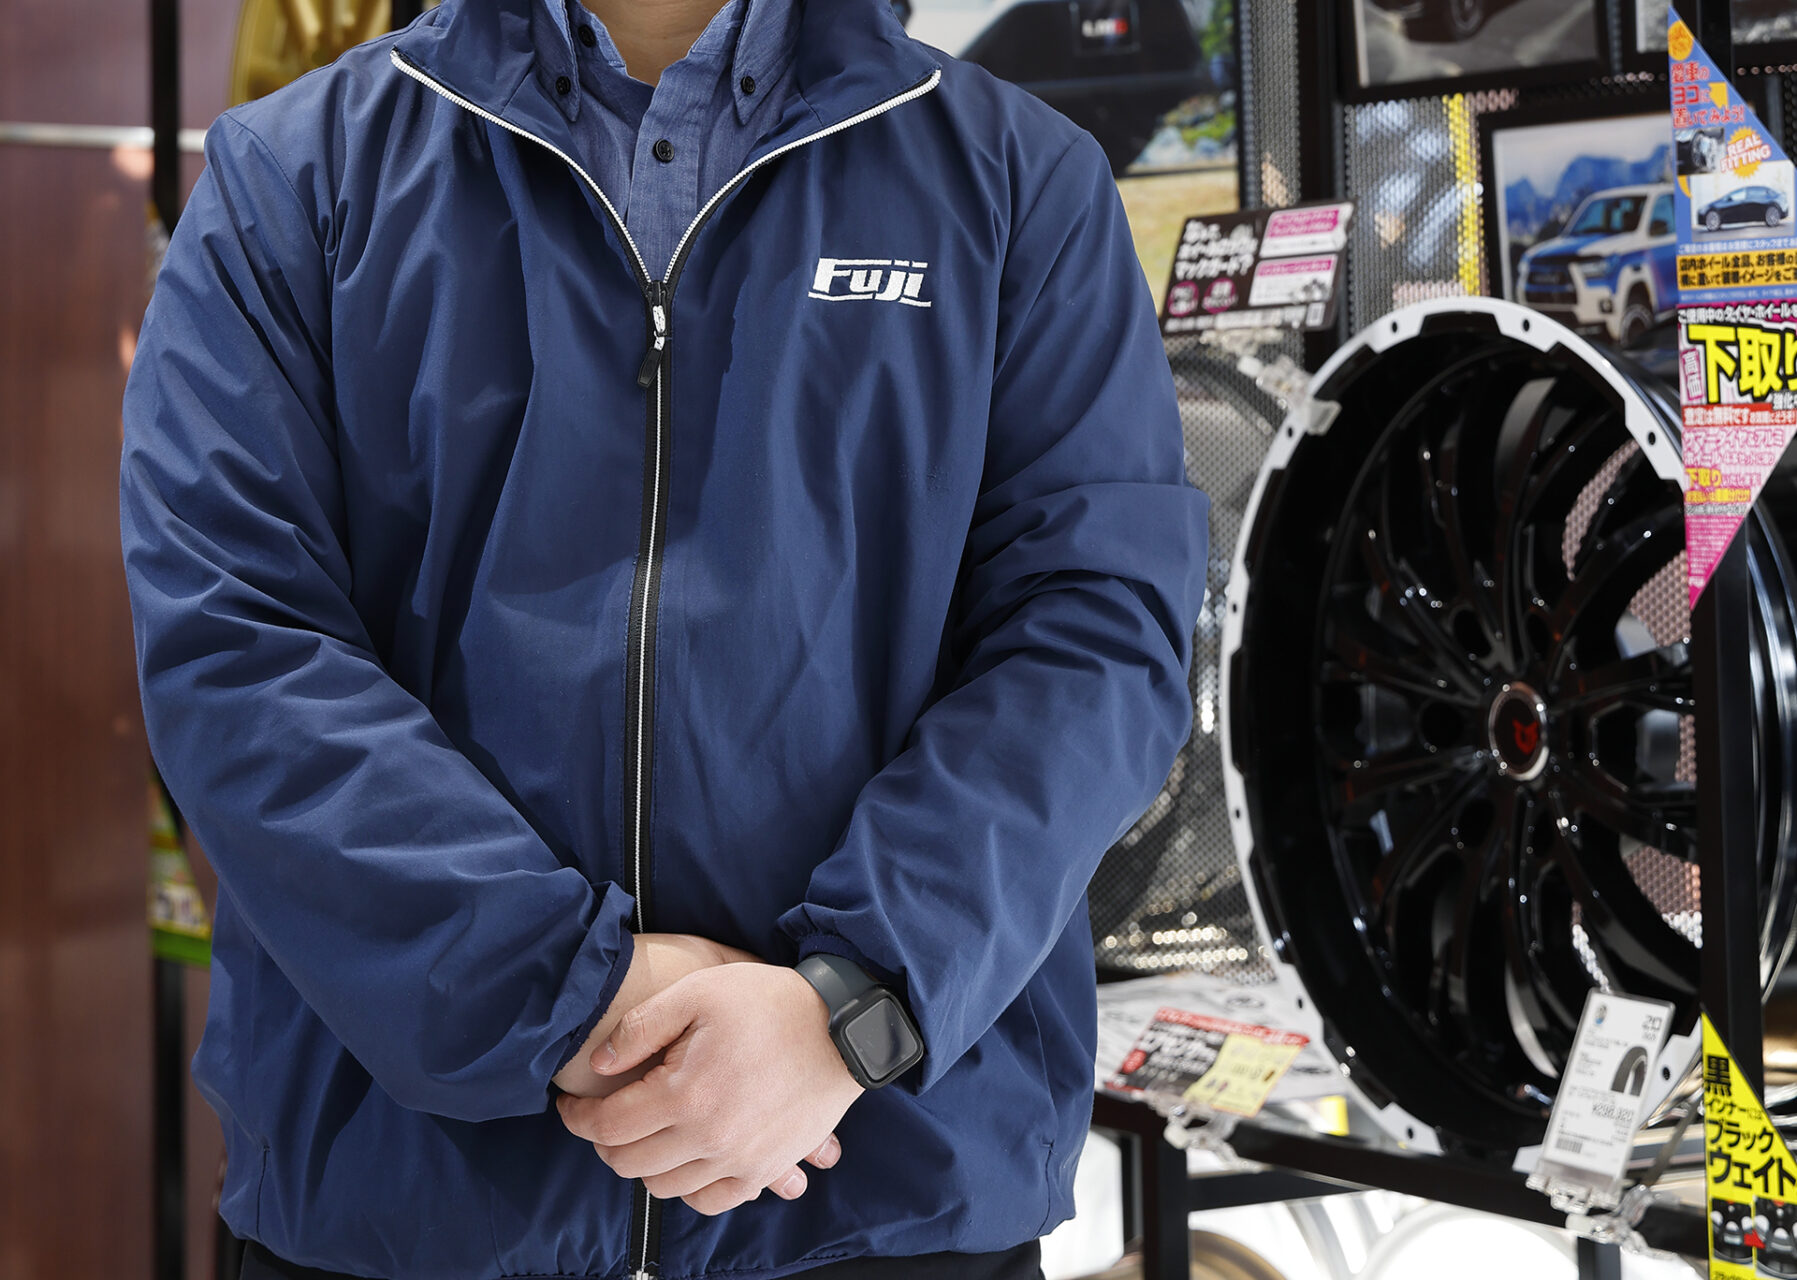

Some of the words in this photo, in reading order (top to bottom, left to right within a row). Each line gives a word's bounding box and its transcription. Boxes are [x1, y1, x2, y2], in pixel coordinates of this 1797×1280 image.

[1672, 84, 1710, 106] ヨコに
[1720, 144, 1771, 173] FITTING
[1726, 134, 1762, 157] REAL
[810, 257, 931, 306] Fuji
[1705, 1054, 1732, 1096] 黒
[1707, 1119, 1774, 1154] ブラック
[1709, 1147, 1797, 1196] ウェイト
